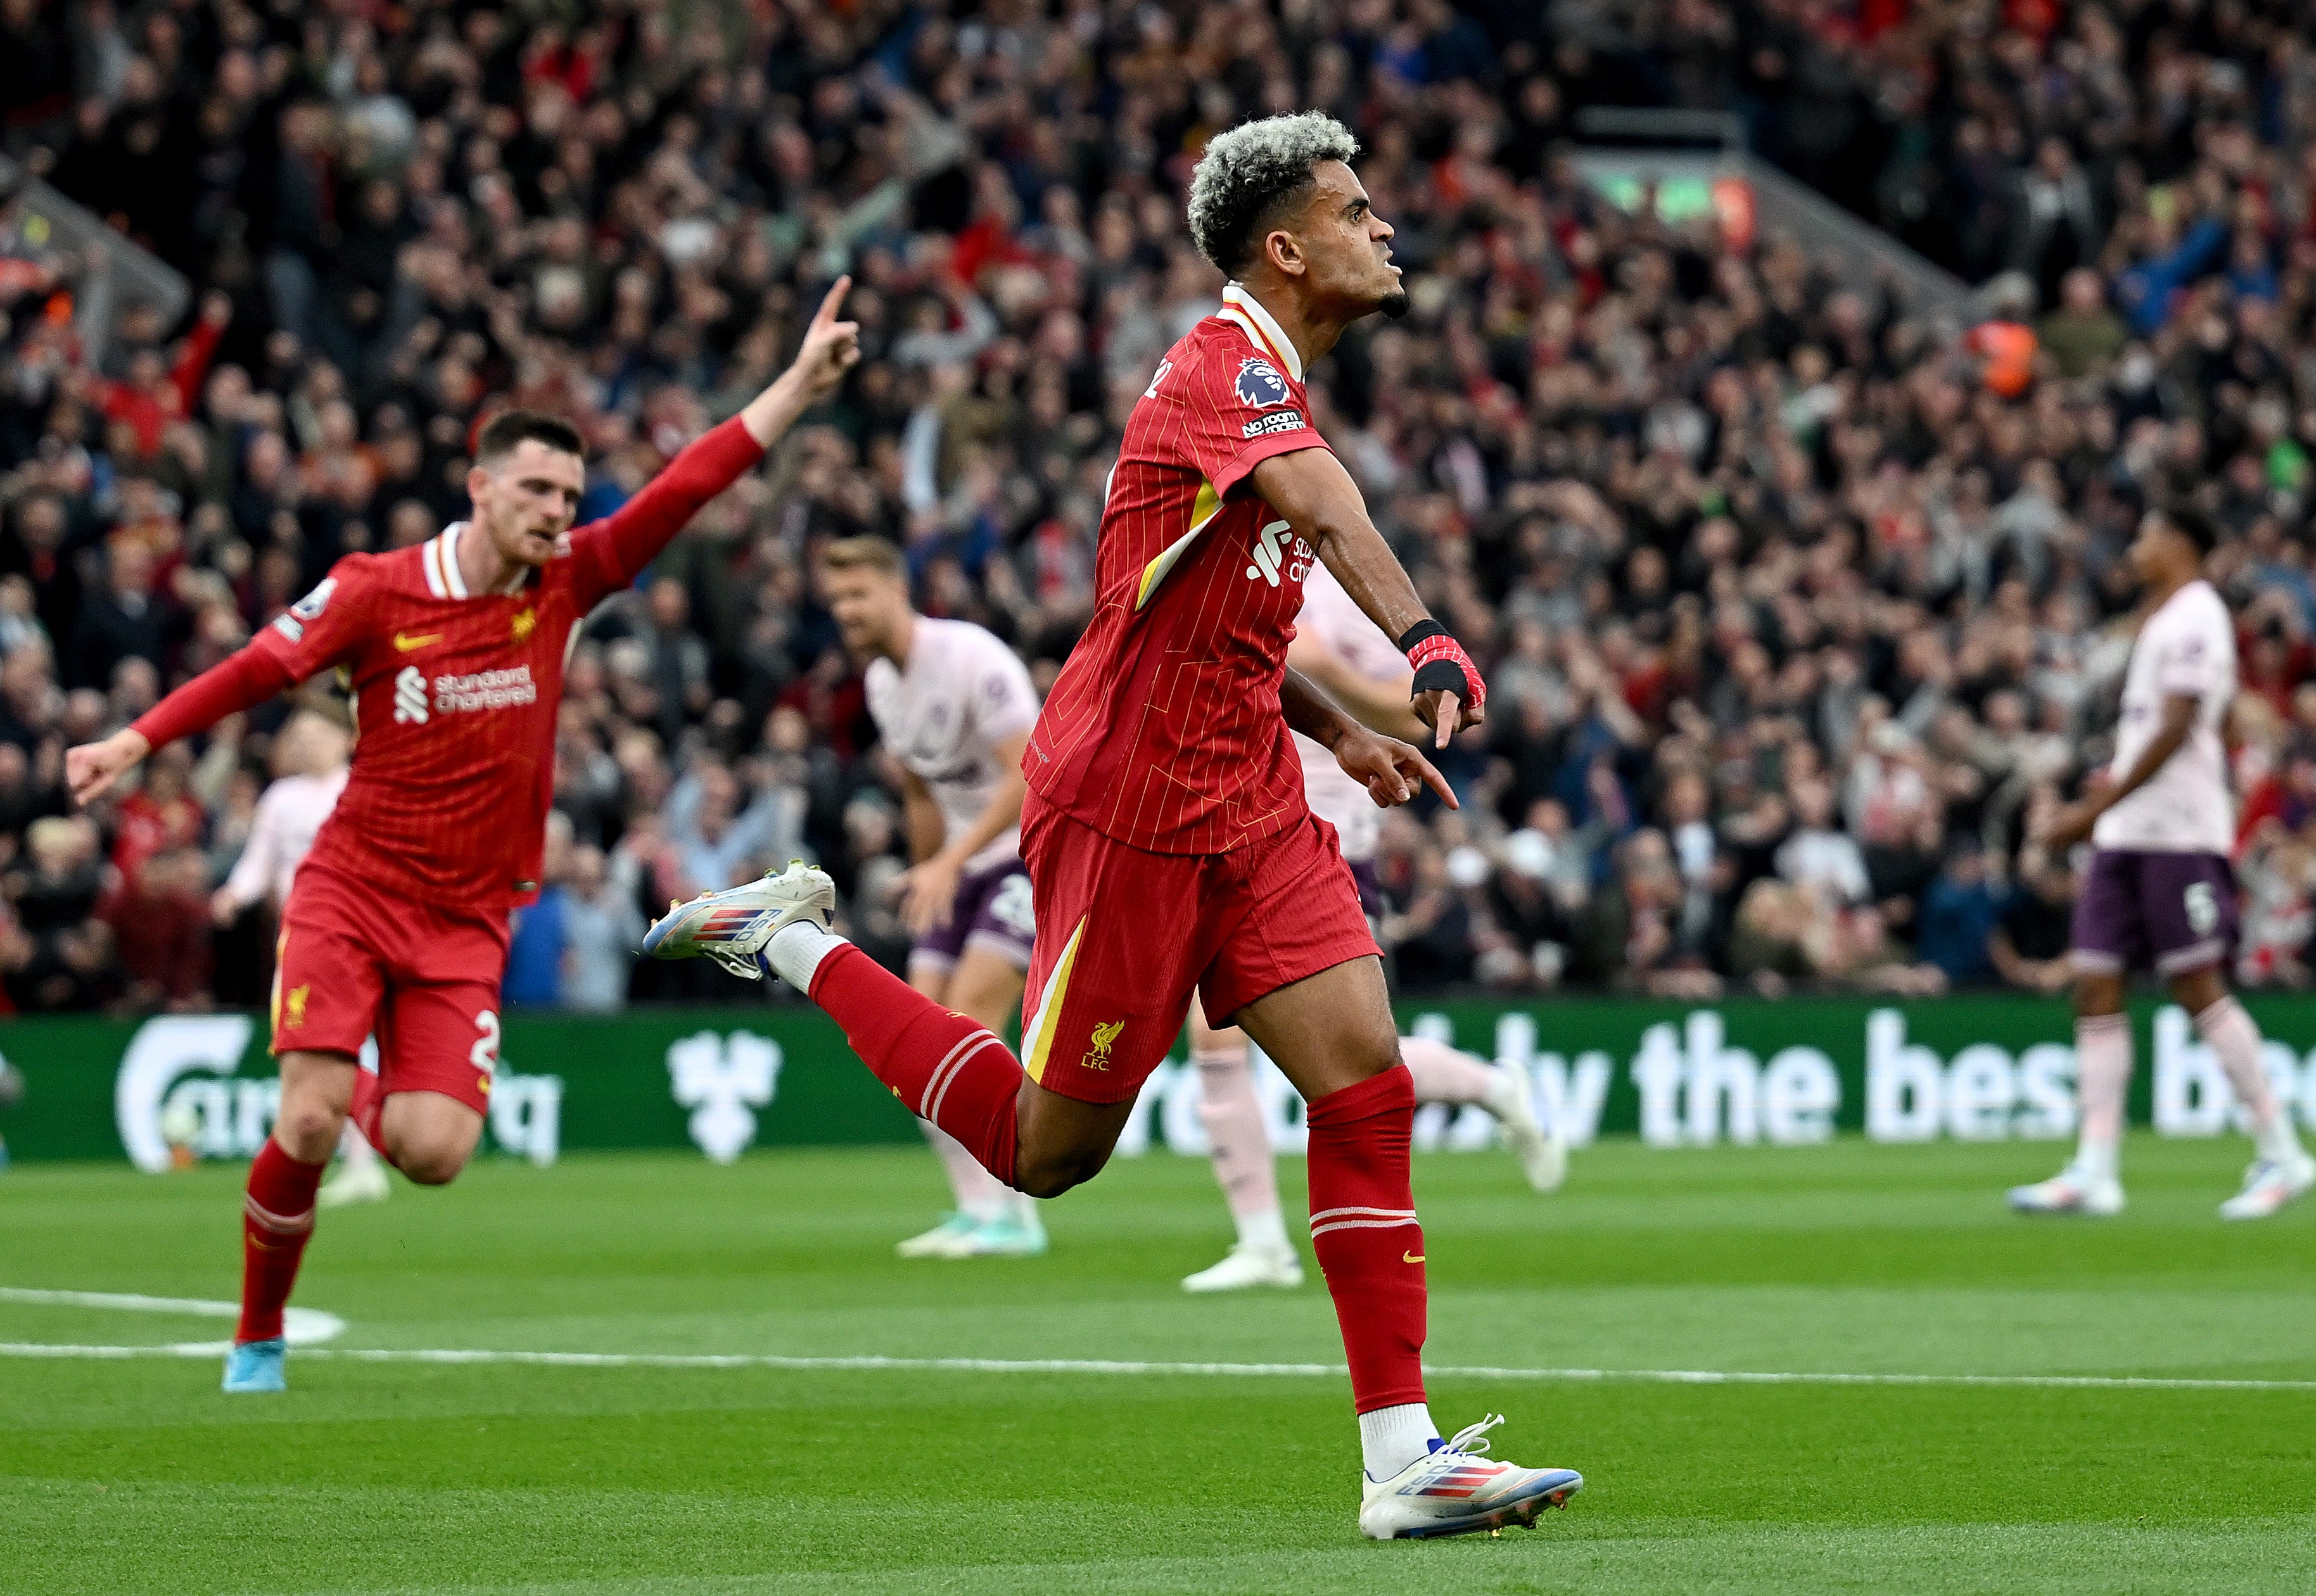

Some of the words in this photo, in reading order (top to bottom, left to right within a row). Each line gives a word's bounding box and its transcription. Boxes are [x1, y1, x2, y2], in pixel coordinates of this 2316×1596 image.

[1242, 421, 1262, 434] No
[1263, 412, 1299, 427] room
[1629, 1010, 1838, 1145] the
[1864, 1006, 2081, 1141] bes
